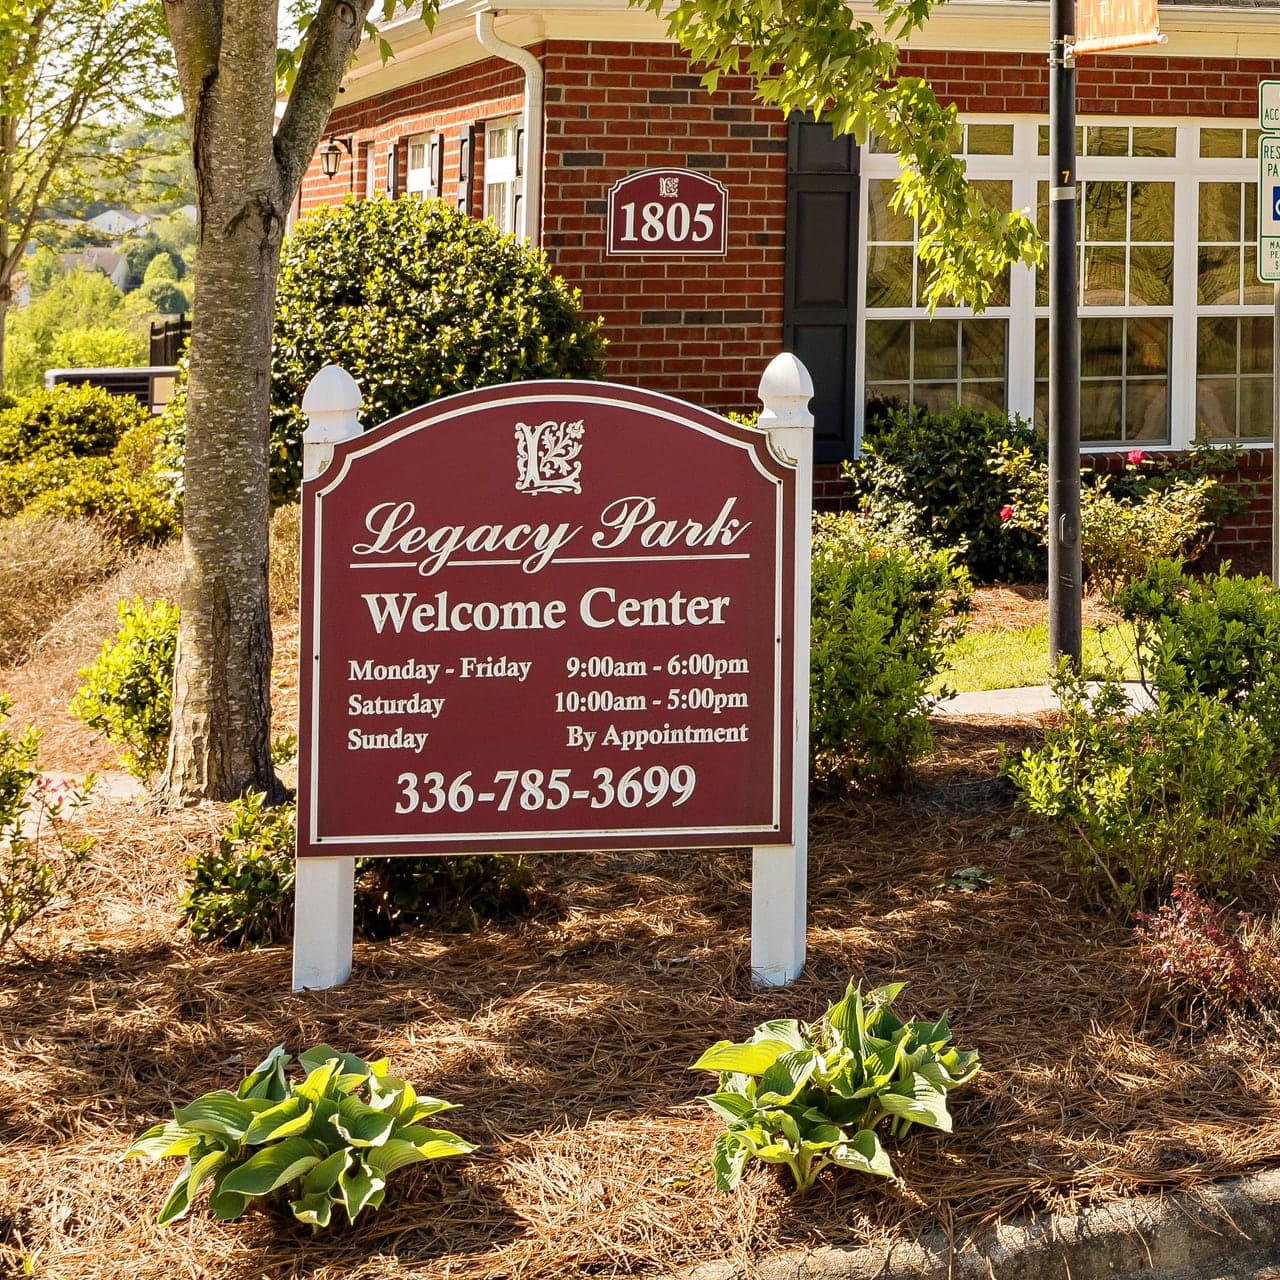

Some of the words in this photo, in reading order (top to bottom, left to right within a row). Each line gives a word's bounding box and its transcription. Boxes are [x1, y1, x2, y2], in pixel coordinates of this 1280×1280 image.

[1062, 170, 1070, 183] 7
[620, 202, 716, 242] 1805
[352, 502, 582, 576] Legacy
[592, 497, 752, 548] Park
[361, 591, 566, 633] Welcome
[580, 587, 730, 628] Center
[348, 659, 440, 684] Monday
[460, 656, 532, 682] Friday
[566, 656, 647, 678] 9:00am
[667, 654, 749, 680] 6:00pm
[348, 693, 445, 718] Saturday
[555, 691, 647, 713] 10:00am
[667, 688, 749, 714] 5:00pm
[348, 728, 428, 754] Sunday
[566, 726, 597, 751] By
[602, 723, 749, 750] Appointment
[395, 765, 696, 814] 336-785-3699
